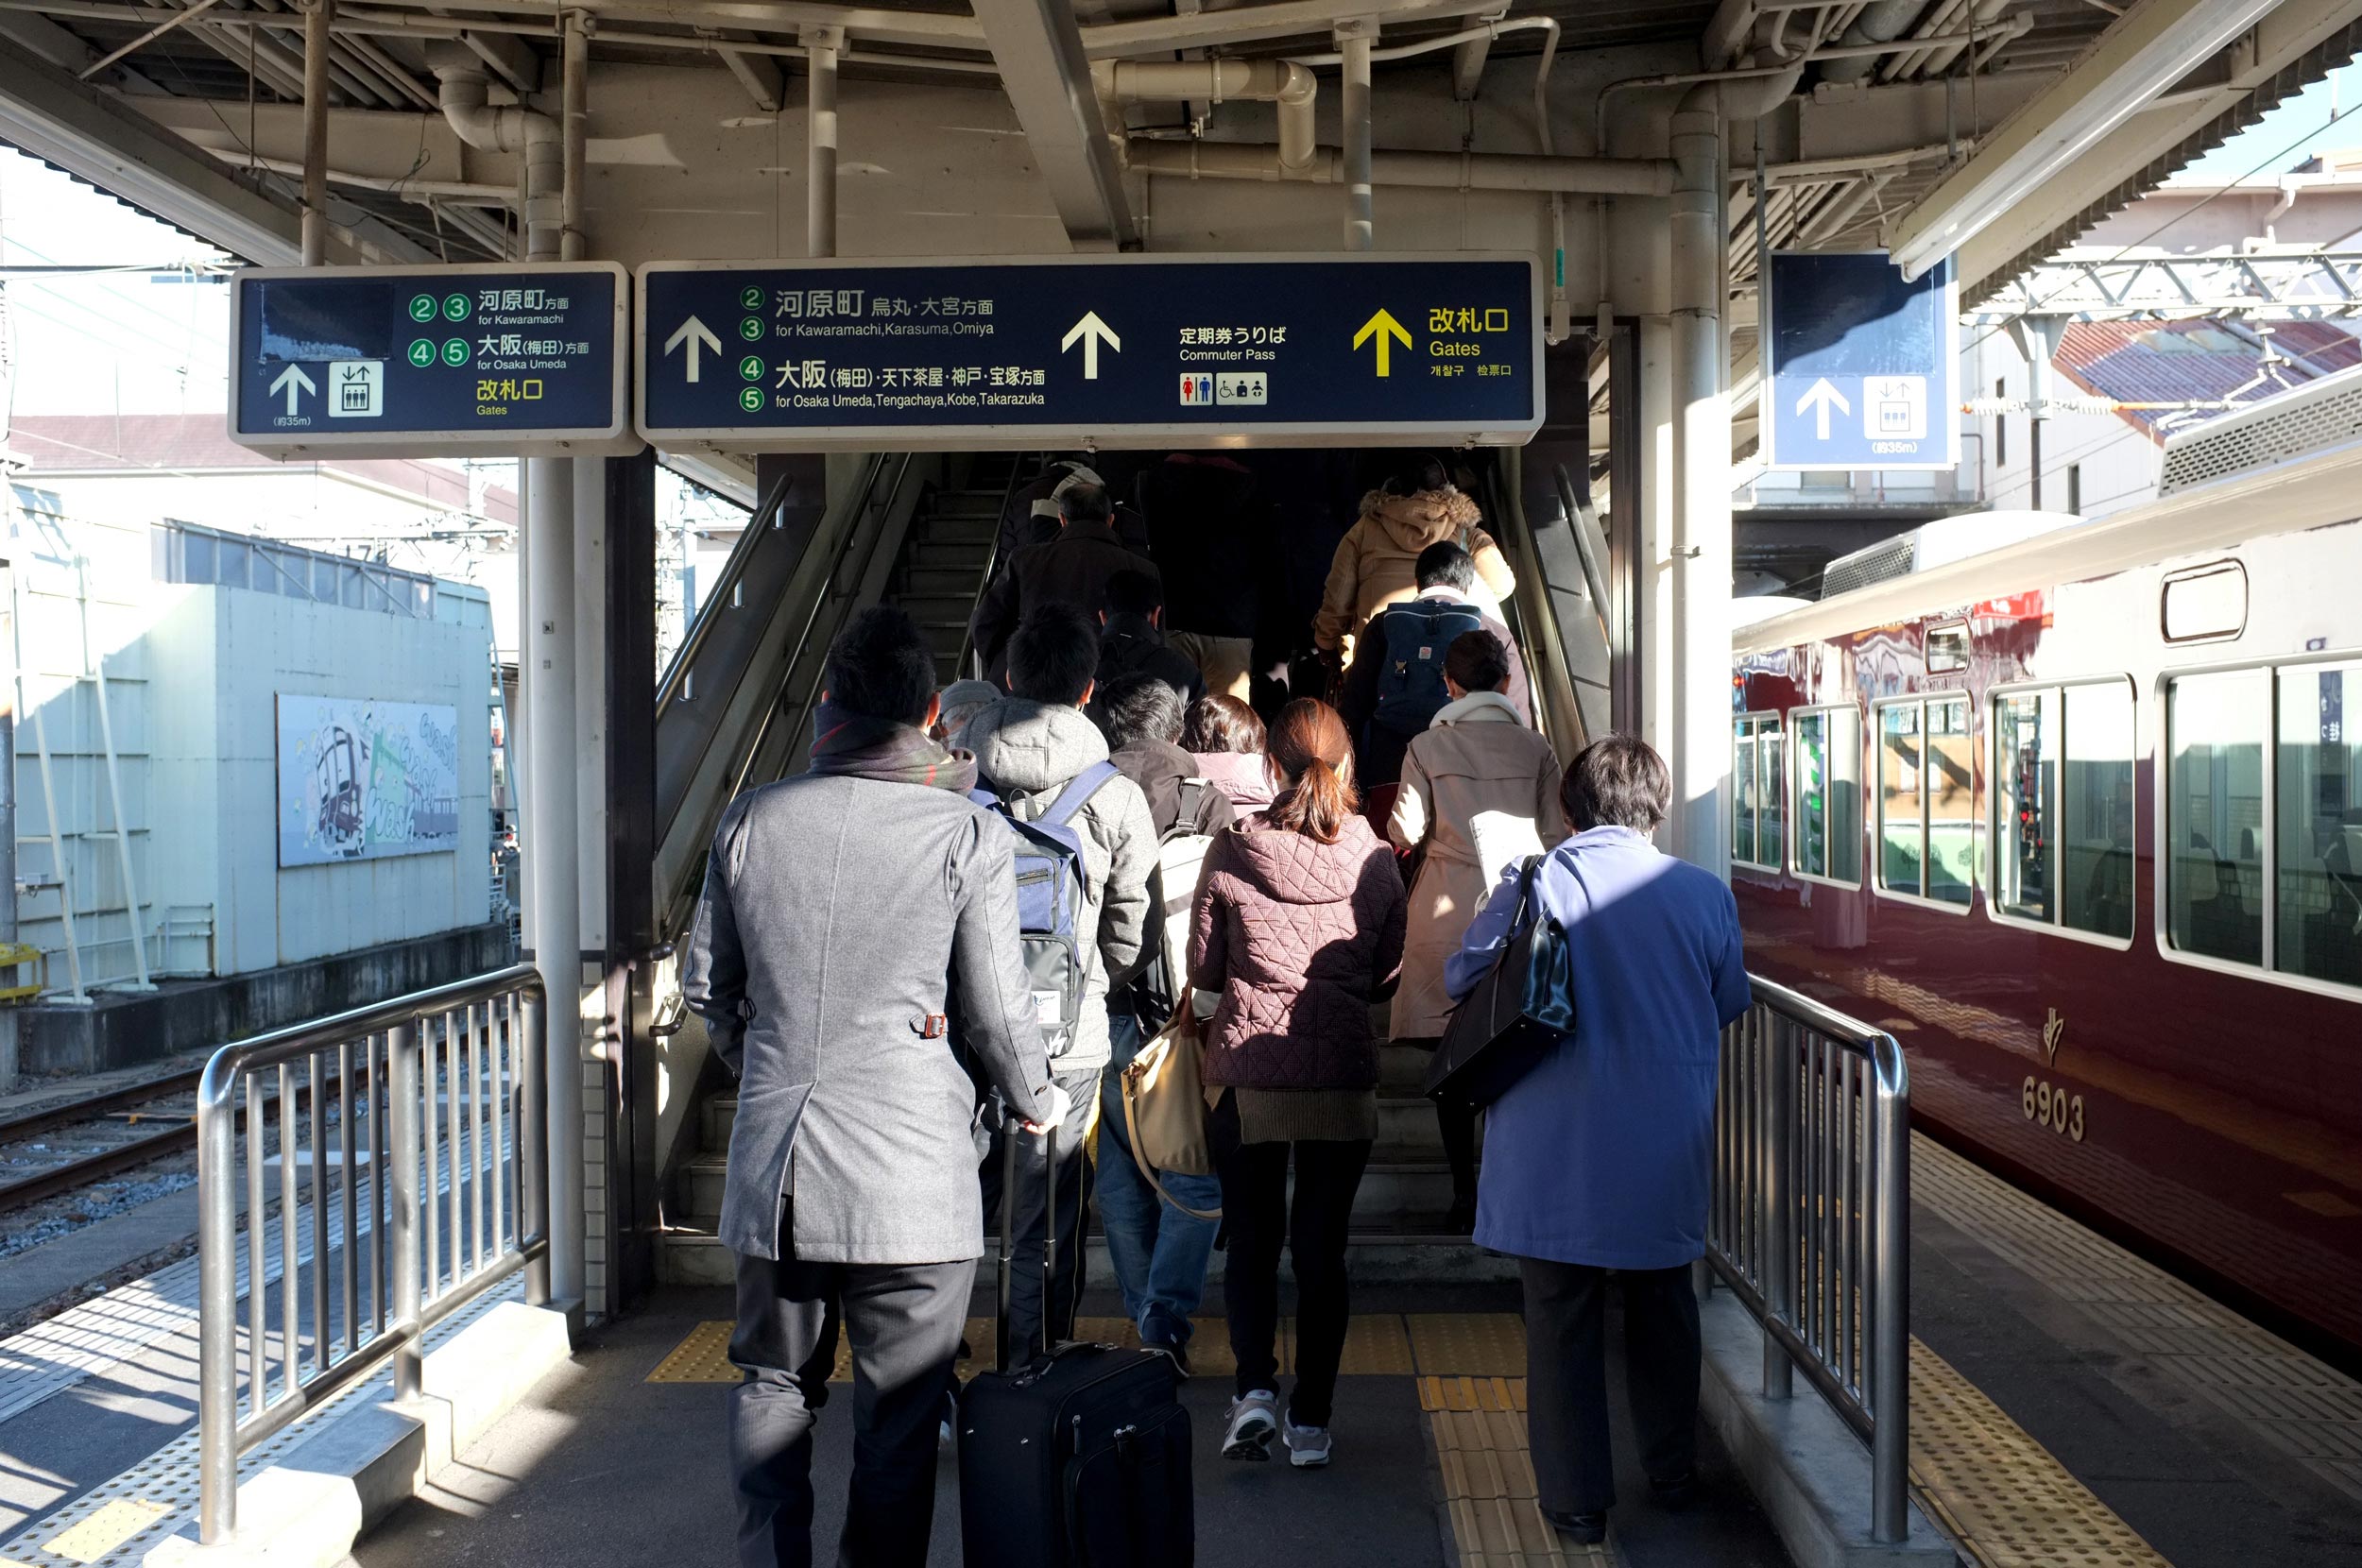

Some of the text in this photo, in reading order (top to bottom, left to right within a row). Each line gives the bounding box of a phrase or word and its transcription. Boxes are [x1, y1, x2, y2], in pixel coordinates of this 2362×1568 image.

[478, 289, 570, 312] 河原町方面
[478, 314, 564, 326] for Kawaramachi
[1429, 307, 1509, 333] 改札口
[776, 323, 793, 337] for
[1179, 326, 1287, 345] 定期券うりば
[1179, 349, 1275, 361] Commuter Pass
[1429, 340, 1481, 357] Gates
[477, 359, 567, 370] for Osaka Umeda
[1430, 365, 1465, 377] 개찰구
[476, 379, 543, 401] 改札口
[776, 395, 792, 408] for
[794, 394, 830, 408] Osaka
[476, 404, 508, 417] Gates
[365, 786, 416, 844] Wash
[2022, 1075, 2085, 1143] 6903
